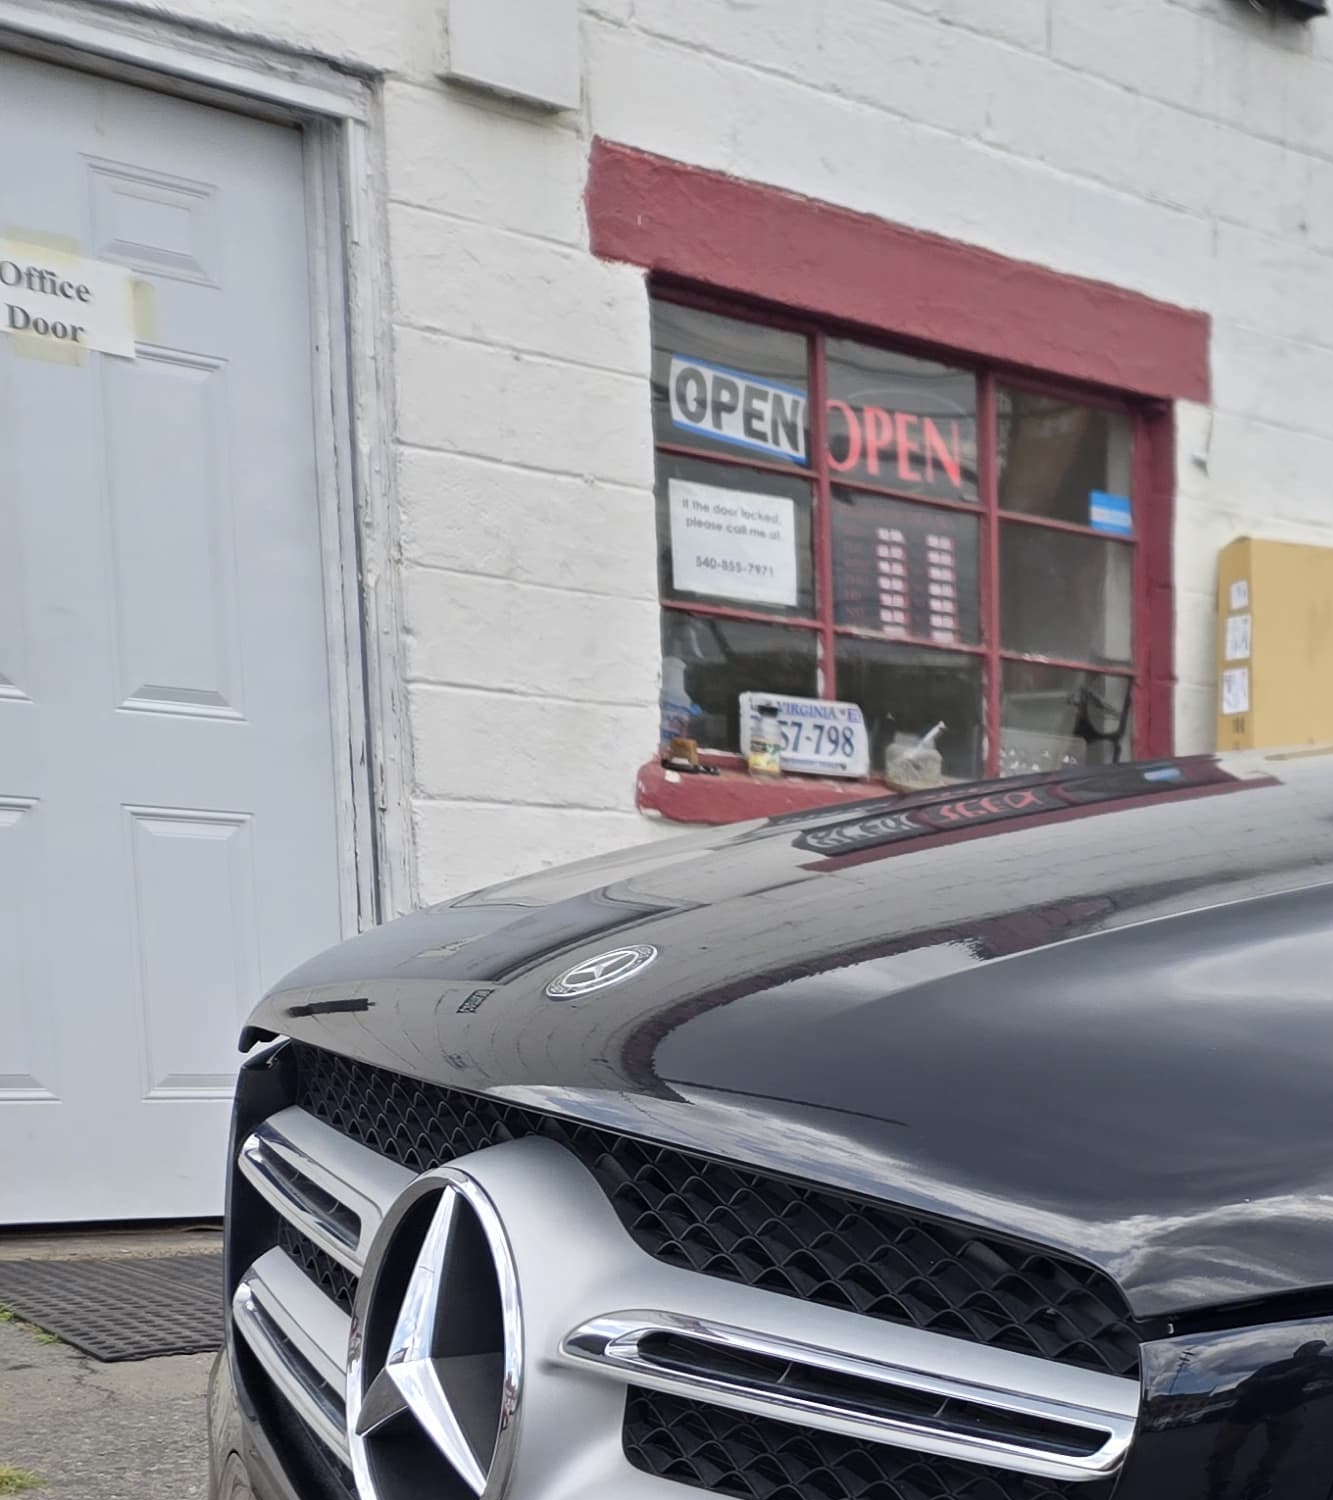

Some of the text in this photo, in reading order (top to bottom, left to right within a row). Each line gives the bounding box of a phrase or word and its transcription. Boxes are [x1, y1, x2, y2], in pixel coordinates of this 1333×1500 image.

[0, 260, 91, 304] Office
[6, 303, 85, 343] Door
[674, 366, 802, 452] OPEN
[826, 399, 962, 489] OPEN
[777, 701, 837, 720] VIRGINIA
